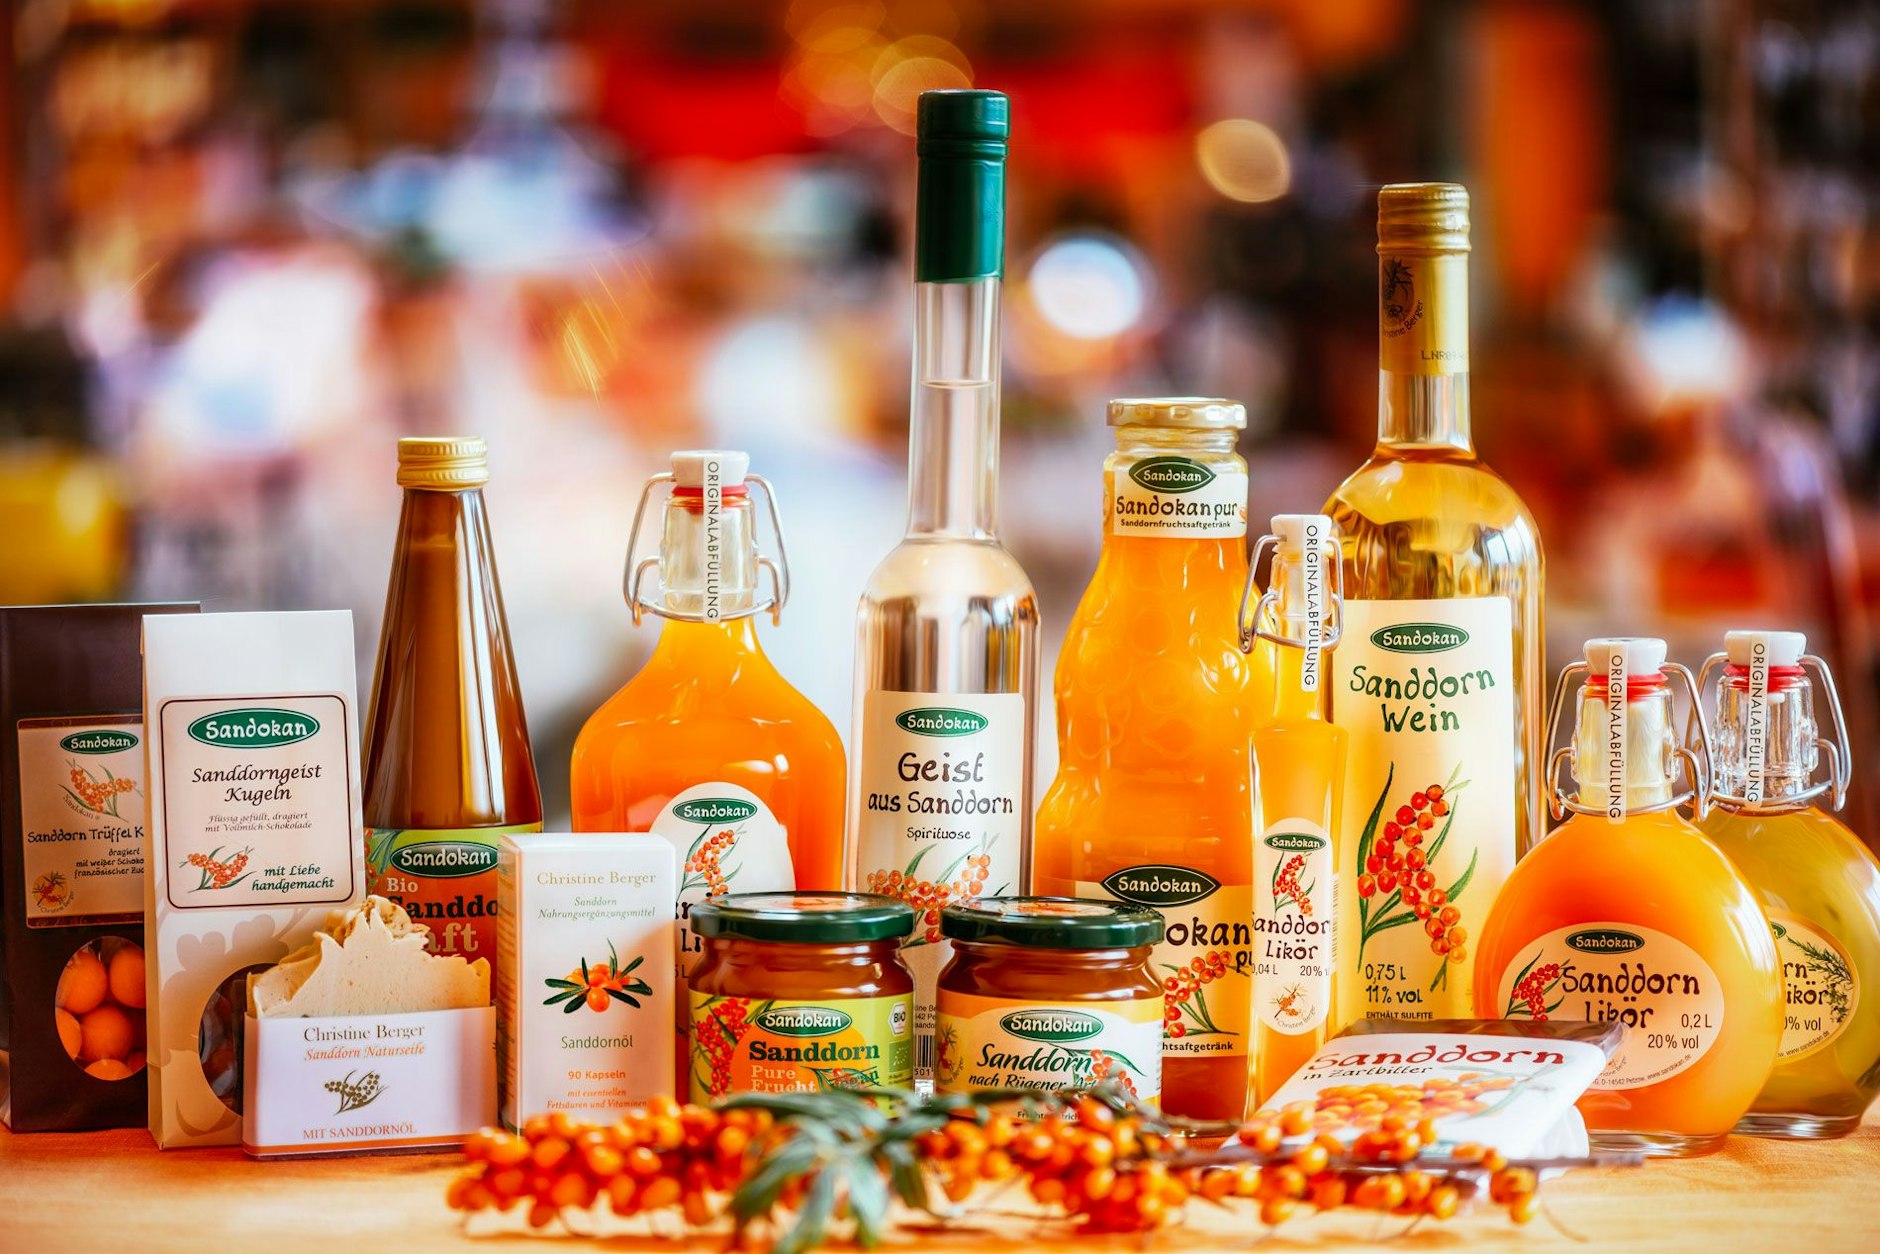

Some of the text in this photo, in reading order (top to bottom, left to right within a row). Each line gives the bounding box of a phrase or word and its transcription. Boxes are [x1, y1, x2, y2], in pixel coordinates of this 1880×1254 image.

[1404, 299, 1424, 330] Berger
[1143, 469, 1202, 482] Sandokan
[1116, 495, 1238, 520] Sandokan pur
[1121, 519, 1231, 530] Sanddornfruchtsaftgetränk
[707, 461, 720, 619] ORIGINALABFÜLLUNG
[1304, 525, 1321, 686] ORIGINALABFÜLLUNG
[1382, 630, 1460, 646] Sandokan
[1350, 665, 1495, 700] Sanddorn
[907, 714, 980, 730] Sandokan
[1381, 703, 1460, 732] Wein
[1748, 643, 1765, 802] ORIGINALABFÜLLUNG
[206, 718, 308, 739] Sandokan
[70, 736, 131, 750] Sandokan
[1609, 655, 1624, 819] ORIGINALABFÜLLUNG
[192, 763, 322, 786] Sanddorngeist
[897, 752, 985, 782] Geist
[224, 783, 292, 806] Kugeln
[868, 790, 1013, 815] aus Sanddorn
[272, 812, 308, 823] dragiert
[683, 804, 751, 818] Sandokan
[27, 829, 87, 843] Sanddorn
[88, 826, 132, 843] Trüffel
[205, 824, 220, 833] mit
[907, 827, 971, 841] Spirituose
[1272, 836, 1321, 849] Sandokan
[108, 847, 140, 858] dragiert
[400, 848, 492, 866] Sandokan
[75, 860, 89, 868] mit
[264, 864, 321, 877] mit Liebe
[74, 867, 130, 880] französischer
[537, 871, 657, 888] Christine Berger
[251, 877, 335, 893] handgemacht
[386, 877, 419, 893] Bio
[1118, 877, 1202, 893] Sandokan
[574, 896, 617, 907] Sanddorn
[537, 907, 656, 921] Nahrungsergänzungsmittel
[1252, 911, 1330, 935] anddor
[1266, 938, 1319, 960] Likör
[1575, 936, 1637, 949] Sandokan
[1272, 964, 1278, 975] L
[1365, 963, 1396, 984] 0,75
[1562, 962, 1701, 995] Sanddorn
[765, 1013, 842, 1029] Sandokan
[1366, 1011, 1433, 1019] ENTHÄLT SULFITE
[1681, 1013, 1712, 1030] 0,2 L
[1010, 1016, 1093, 1034] Sandokan
[1804, 1017, 1822, 1031] vol
[304, 1024, 425, 1042] Christine Berger
[561, 1034, 633, 1049] Sanddornöl
[1681, 1034, 1700, 1049] vol
[304, 1042, 425, 1061] Sanddorn Naturseife
[749, 1040, 880, 1062] Sanddorn
[976, 1043, 1093, 1073] Sanddorn
[1308, 1044, 1565, 1071] Sanddorn
[567, 1070, 627, 1082] 90 Kapseln
[751, 1065, 797, 1079] Pure
[968, 1072, 1000, 1088] nach
[1303, 1065, 1433, 1081] in Zartbitter
[567, 1087, 627, 1098] mit essentiellen
[751, 1080, 817, 1094] Frucht
[590, 1099, 606, 1109] und
[607, 1099, 648, 1108] Vitaminen
[303, 1123, 417, 1140] MIT SANDDORNÖL
